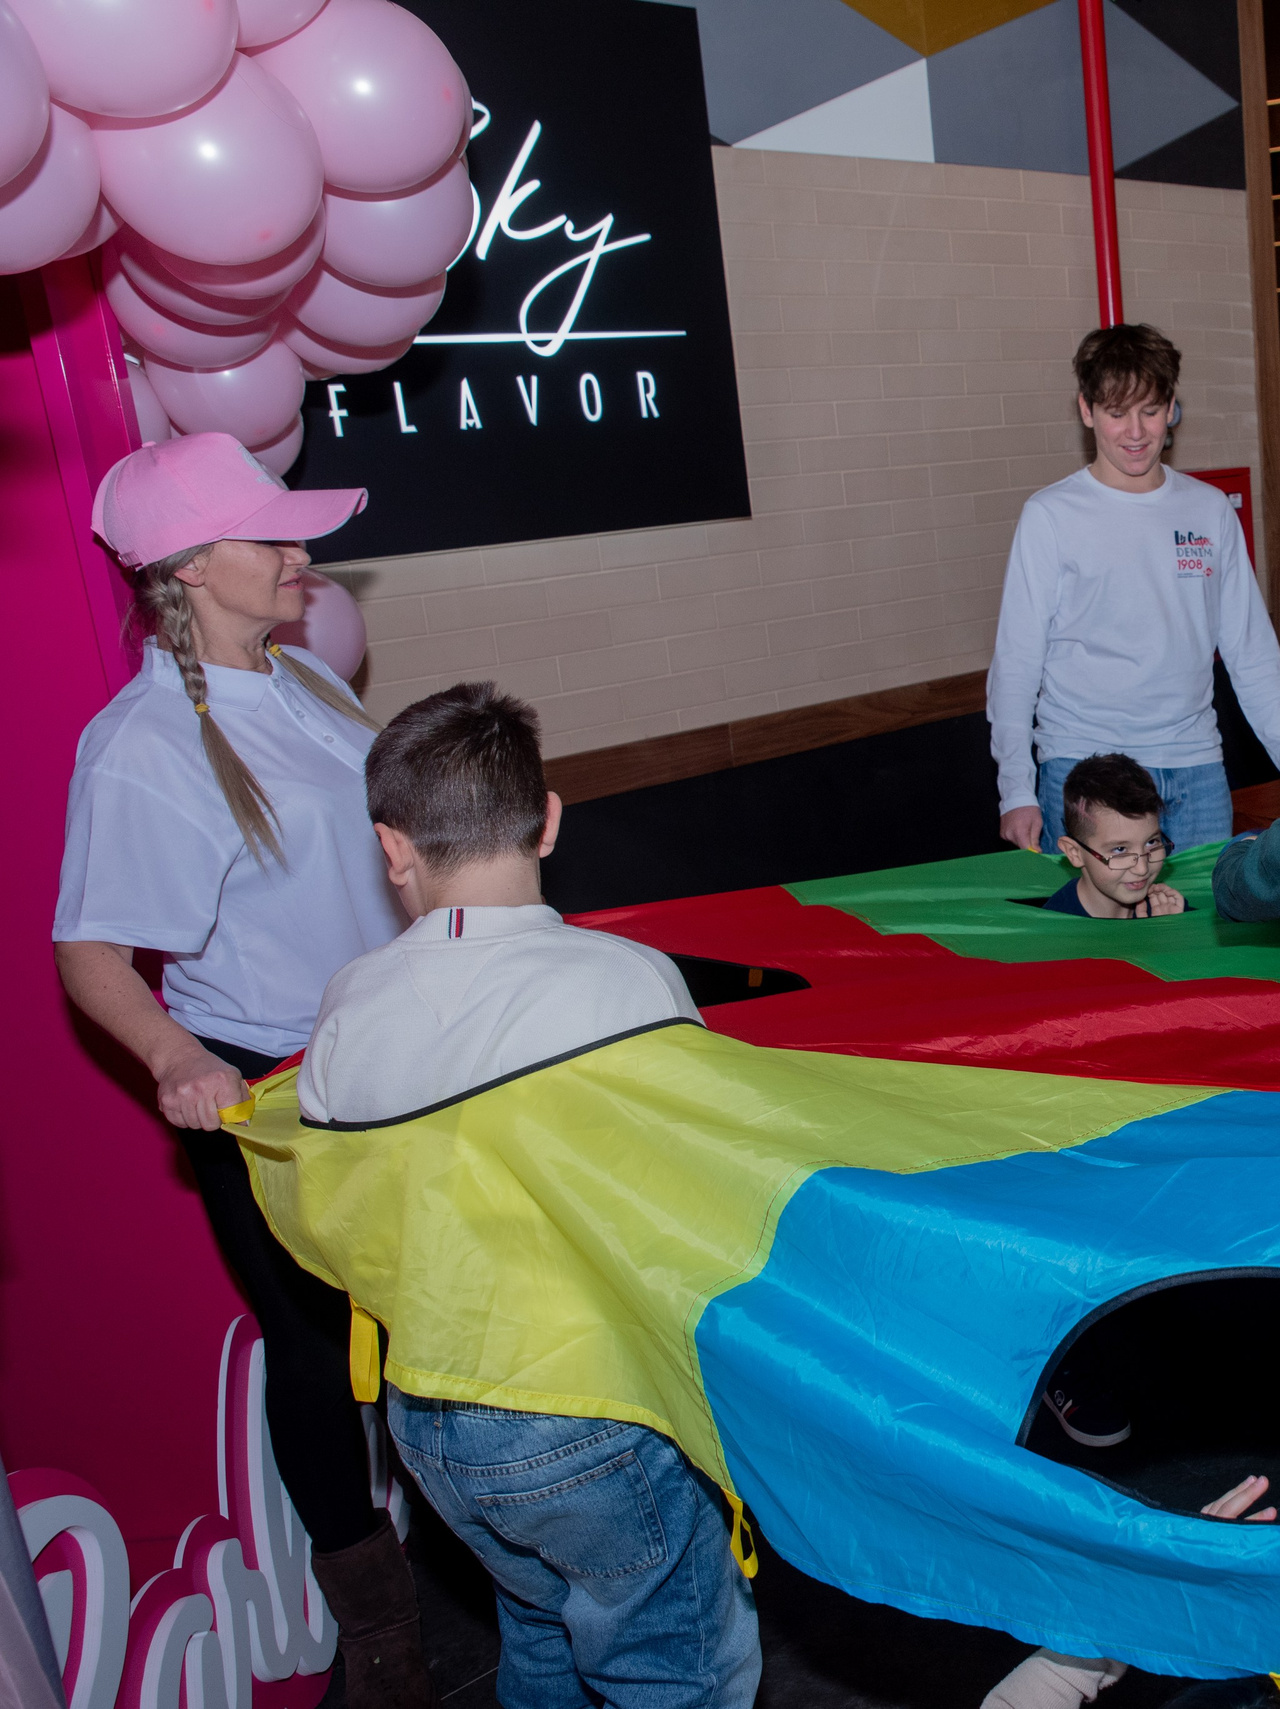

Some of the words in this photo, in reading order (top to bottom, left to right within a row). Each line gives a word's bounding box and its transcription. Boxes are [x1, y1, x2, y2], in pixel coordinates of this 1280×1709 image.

[327, 370, 661, 438] FLAVOR
[1176, 547, 1213, 557] DENIM
[1177, 559, 1203, 570] 1908
